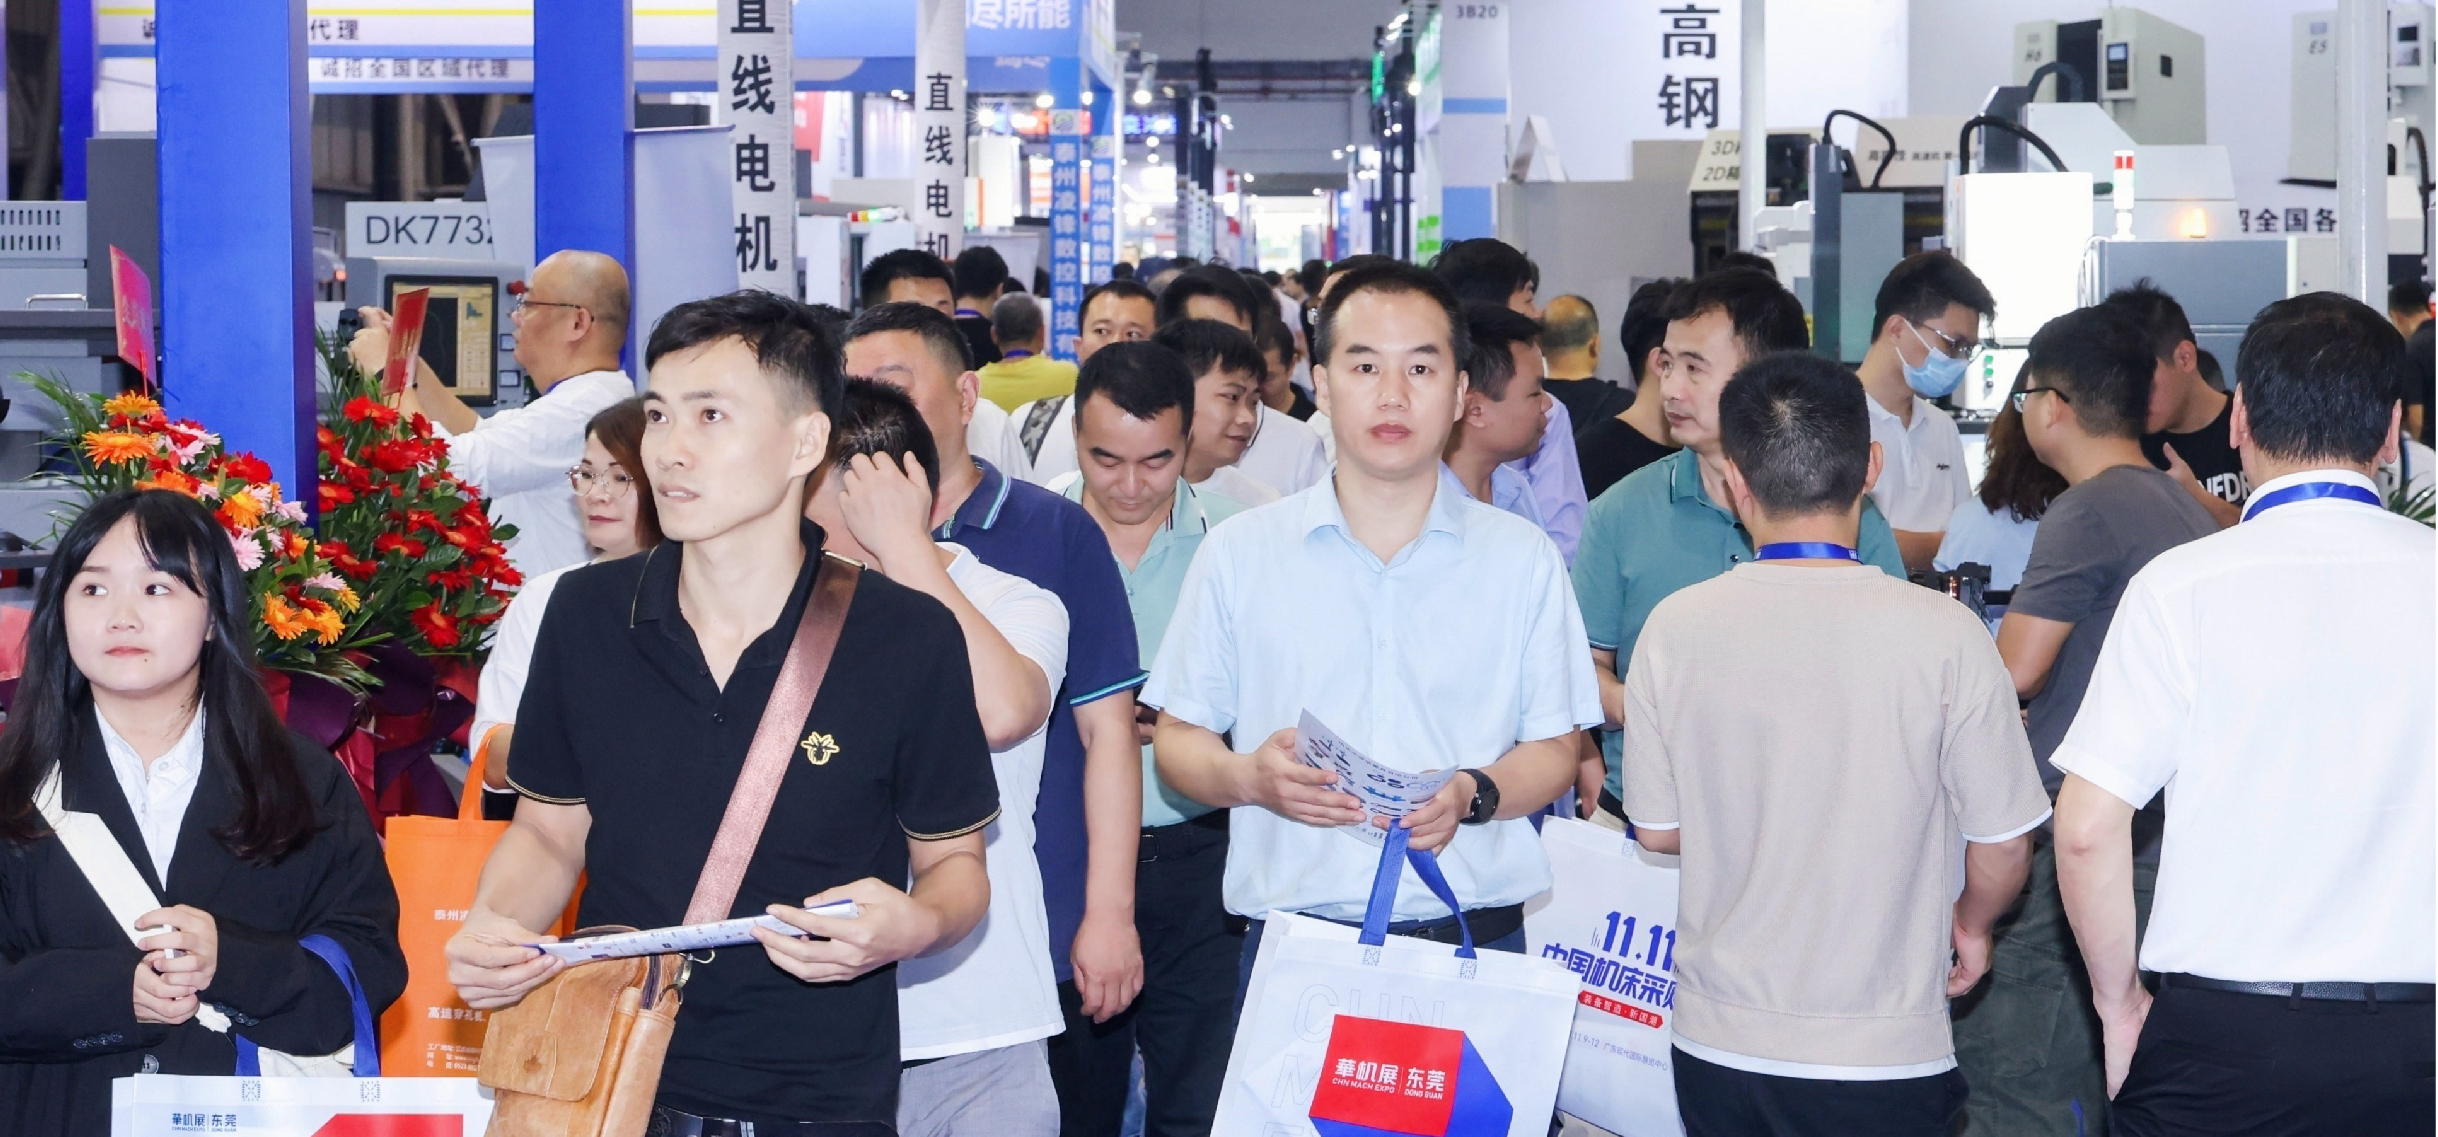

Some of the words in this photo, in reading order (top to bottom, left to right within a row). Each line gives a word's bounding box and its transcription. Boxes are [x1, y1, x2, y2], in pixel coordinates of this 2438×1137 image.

[966, 0, 1071, 30] 尽所能
[310, 19, 359, 41] 代理
[321, 57, 510, 79] 诚招全国区域代理
[1658, 4, 1720, 129] 高钢
[730, 0, 778, 272] 直线电机
[924, 72, 954, 258] 直线电机
[1331, 1077, 1350, 1087] CHN
[1350, 1080, 1373, 1090] MACH
[1374, 1083, 1395, 1094] EXPO
[1406, 1066, 1446, 1092] 东莞
[211, 1113, 237, 1128] 东莞
